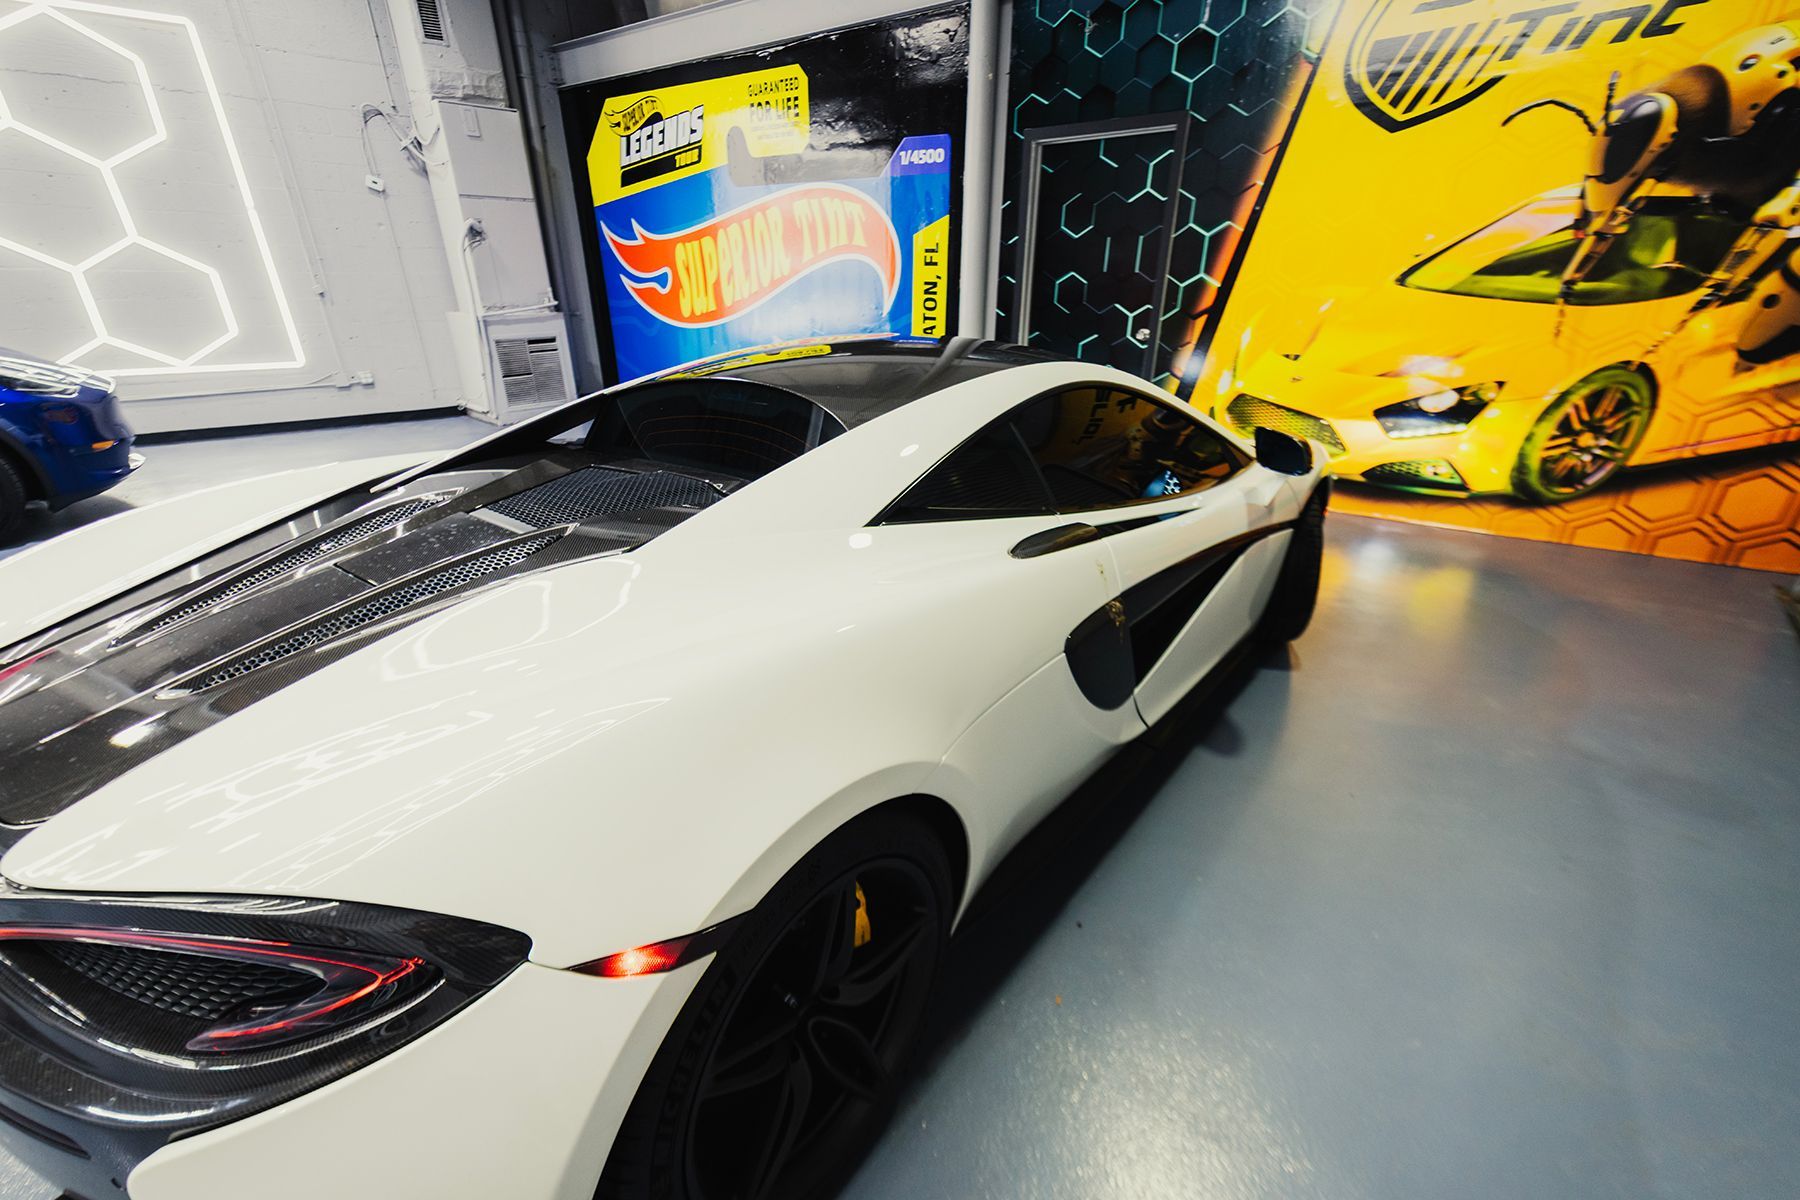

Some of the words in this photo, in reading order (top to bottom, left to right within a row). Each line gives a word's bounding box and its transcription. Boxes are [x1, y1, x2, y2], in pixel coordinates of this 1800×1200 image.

[747, 77, 800, 97] GUARANTEED
[750, 101, 772, 122] FOR
[776, 96, 800, 119] LIFE
[620, 104, 704, 168] LEGENDS
[900, 148, 945, 165] 1/4500
[675, 206, 792, 318] SUPERIOR
[792, 197, 868, 264] TINT
[924, 242, 939, 267] FL
